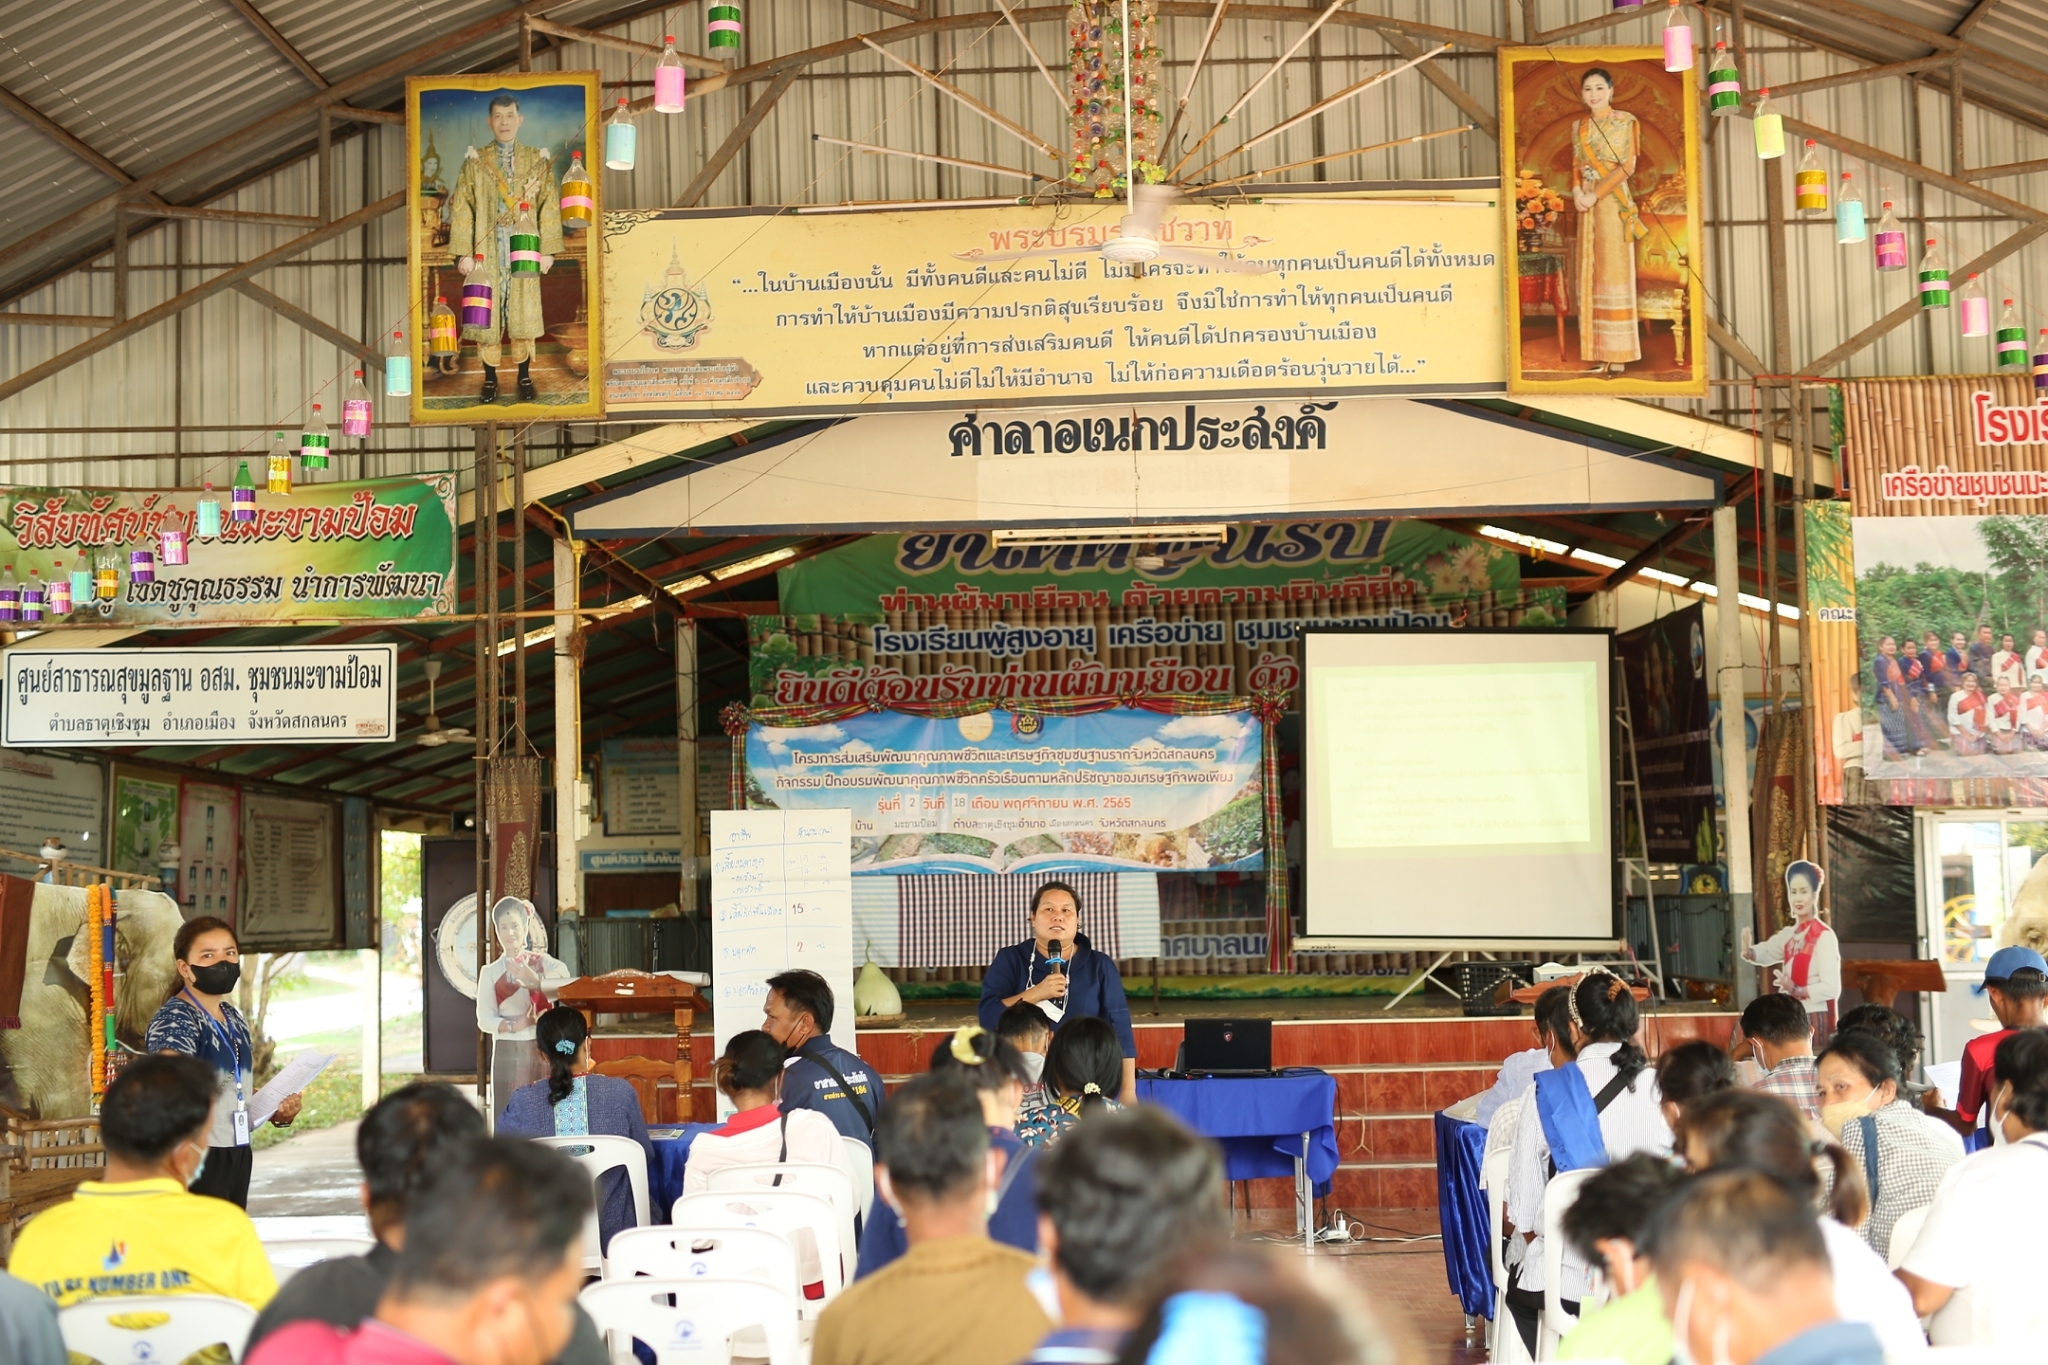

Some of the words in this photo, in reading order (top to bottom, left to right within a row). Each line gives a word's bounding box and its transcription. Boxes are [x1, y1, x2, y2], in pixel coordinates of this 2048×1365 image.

[905, 259, 1087, 288] มีทั้งคนดีและคนไม่ดี
[776, 295, 1163, 328] การทำให้บ้านเมืองมีความปรกติสุขเรียบร้อย
[1176, 283, 1453, 313] จึงมิใช่การทำให้ทุกคนเป็นคนดี
[862, 321, 1113, 365] หากแต่อยู่ที่การส่งเสริมคนดี
[1124, 321, 1376, 349] ให้คนดีได้ปกครองบ้านเมือง
[806, 366, 1093, 399] และควบคุมคนไม่ดีไม่ให้มีอำนาจ
[291, 561, 440, 602] นำการพัฒนา
[874, 625, 1094, 655] โรงเรียนผู้สูงอายุ
[1109, 618, 1223, 645] เครือข่าย
[17, 659, 193, 705] ศูนย์สาธารณสุขมูลฐาน
[199, 667, 240, 692] อสม.
[248, 655, 382, 703] ชุมชนมะขามป้อม
[49, 712, 150, 737] ตำบลธาตุเชิงชุม
[163, 710, 236, 731] อำเภอเมือง
[247, 708, 348, 730] จังหวัดสกลนคร
[776, 776, 821, 788] กิจกรรม
[877, 794, 901, 814] รุ่นที่
[909, 798, 915, 808] 2
[922, 794, 945, 810] วันที่
[953, 797, 966, 807] 18
[971, 796, 999, 809] เดือน
[1003, 796, 1069, 811] พฤศจิกายน
[1073, 797, 1099, 809] พ.ศ.
[1103, 797, 1131, 809] 2565
[855, 819, 873, 830] บ้าน
[894, 818, 938, 829] มะขามป้อม
[1098, 817, 1167, 829] จังหวัดสกลนคร
[792, 903, 804, 915] 15
[796, 941, 805, 952] 2
[89, 1272, 156, 1293] NUMBER
[162, 1270, 191, 1289] ONE
